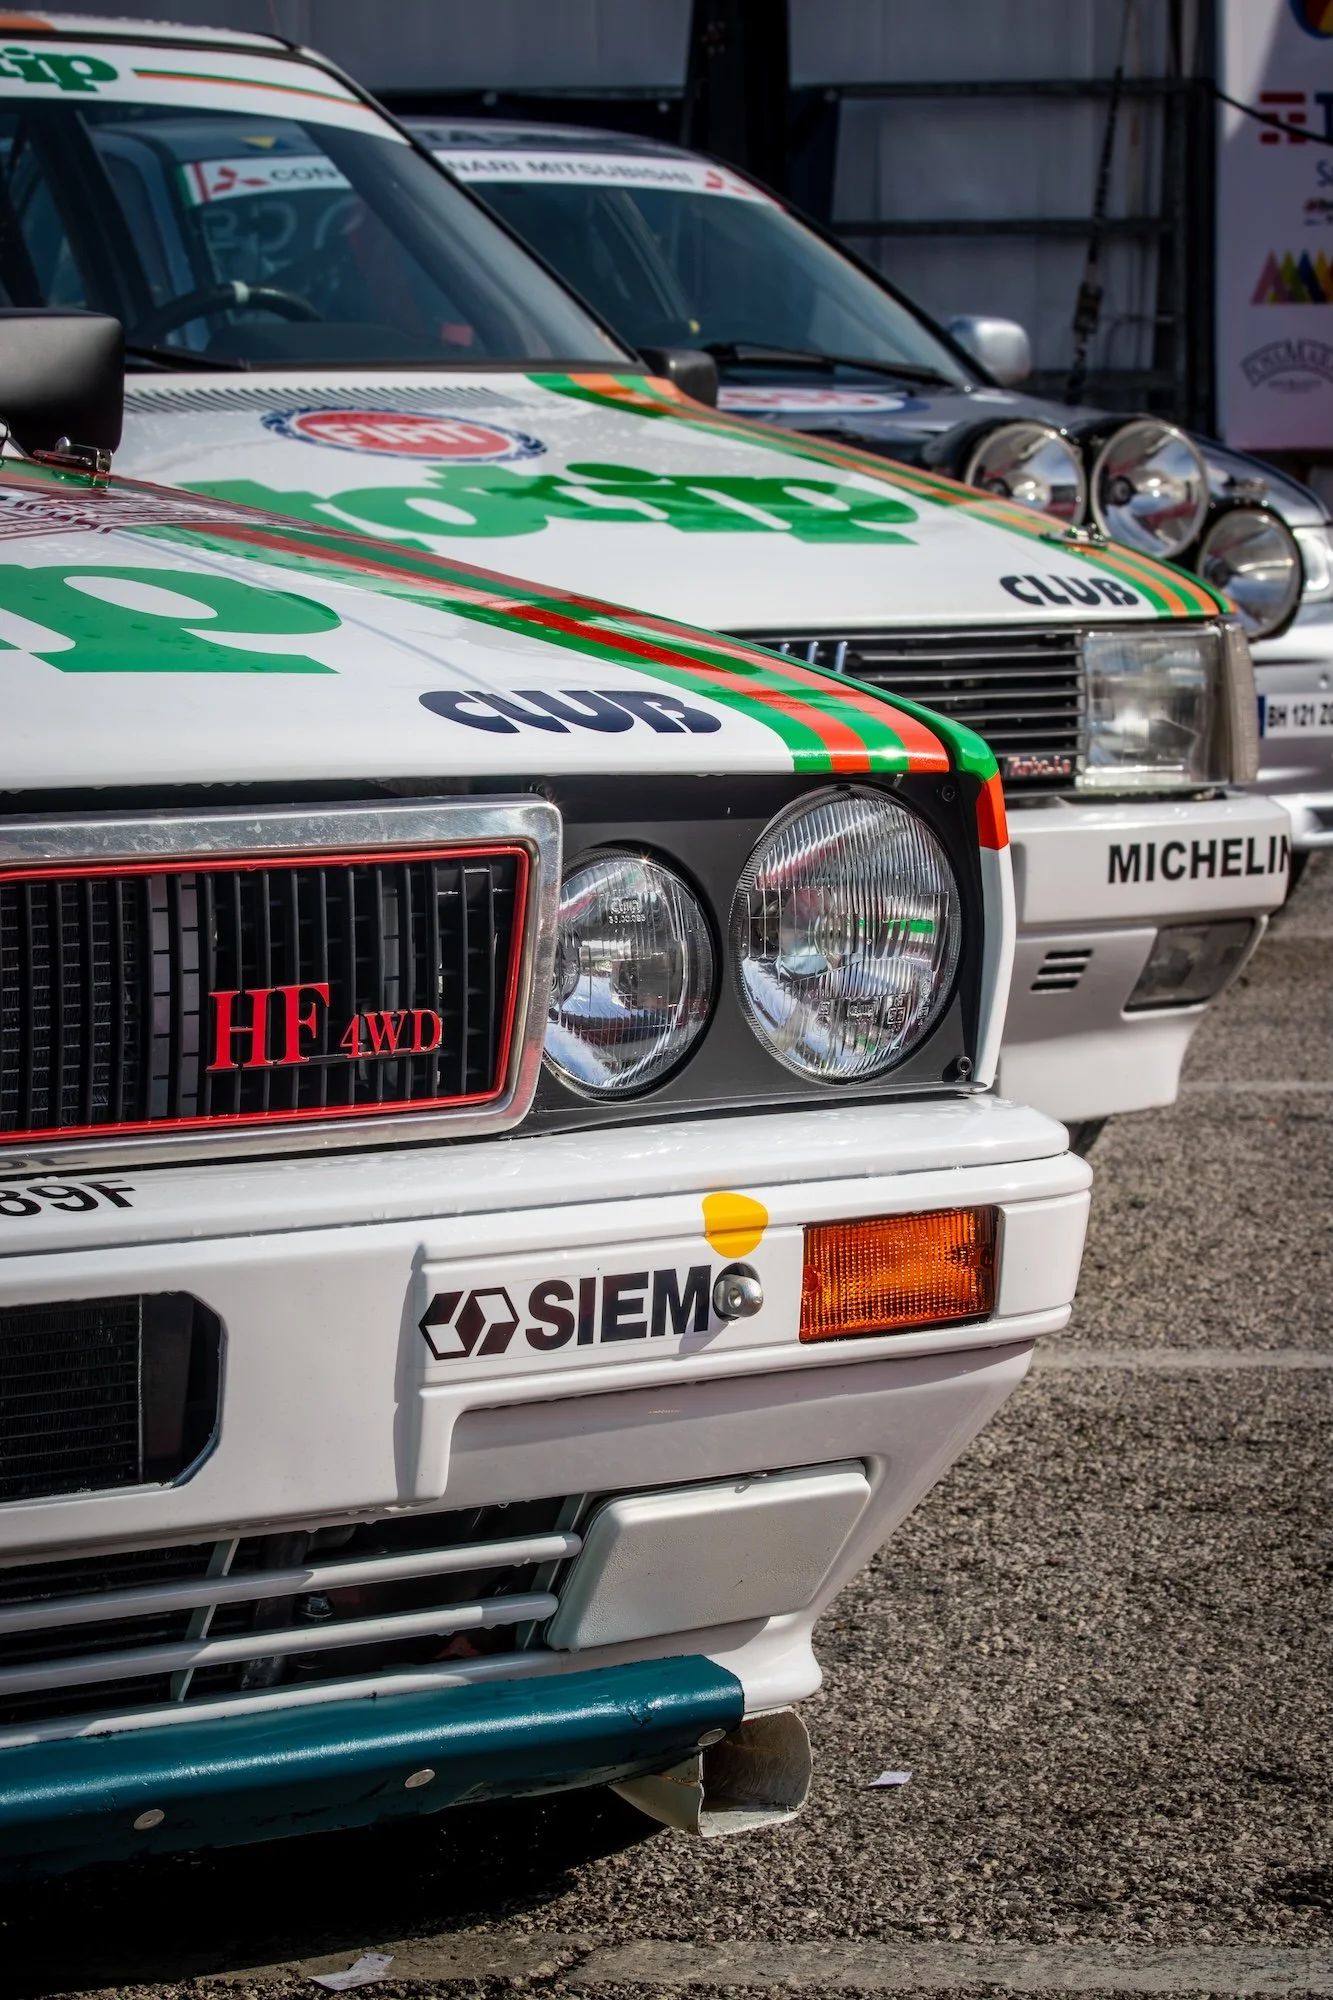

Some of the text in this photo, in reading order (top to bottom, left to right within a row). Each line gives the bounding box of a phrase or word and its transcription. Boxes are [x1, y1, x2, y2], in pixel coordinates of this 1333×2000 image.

[525, 160, 694, 184] MITSUBISHI
[305, 423, 487, 445] FIAT
[998, 574, 1140, 606] CLUB
[0, 564, 343, 674] p
[418, 690, 722, 734] CLUB
[1268, 705, 1287, 727] BH
[1293, 703, 1315, 727] 121
[206, 982, 443, 1071] HF 4WD
[525, 1264, 712, 1351] SIEM
